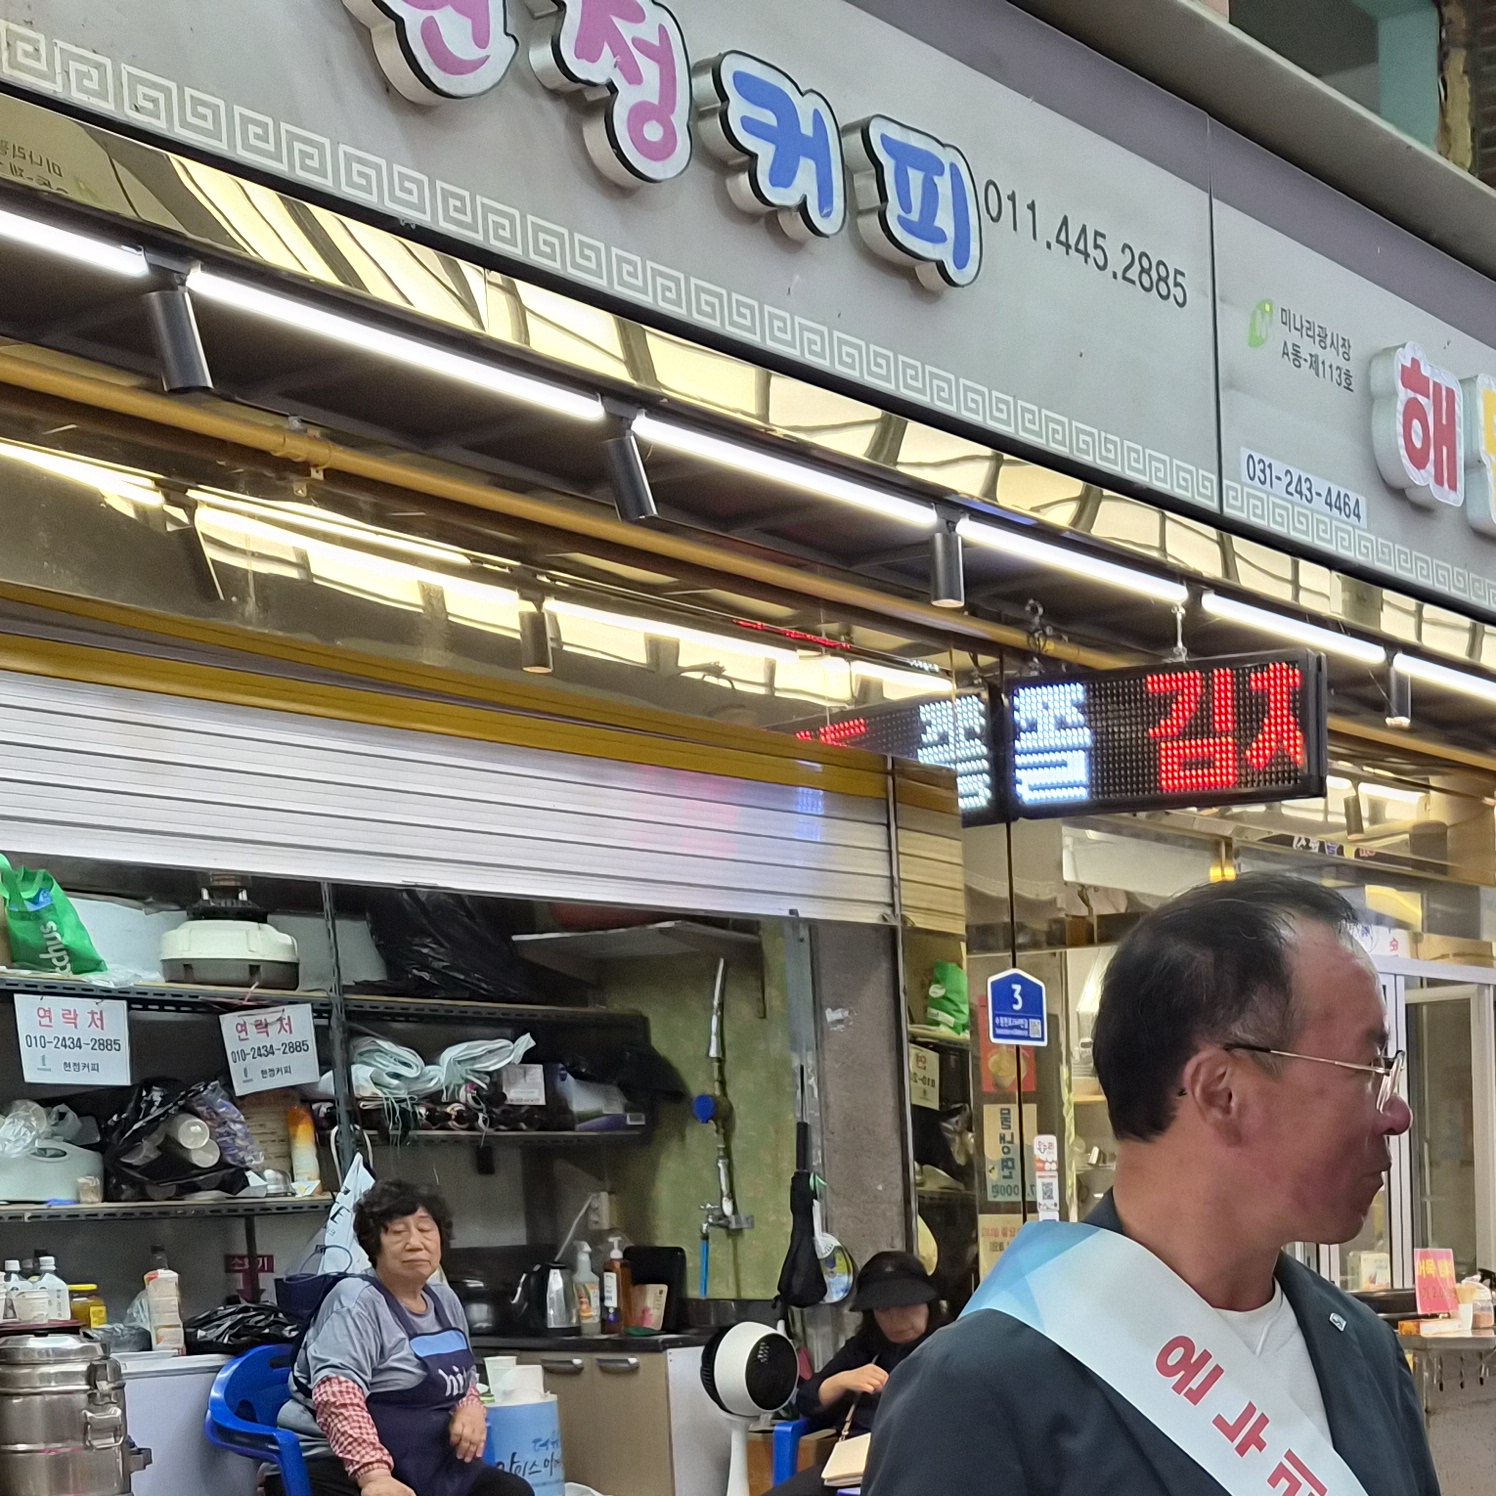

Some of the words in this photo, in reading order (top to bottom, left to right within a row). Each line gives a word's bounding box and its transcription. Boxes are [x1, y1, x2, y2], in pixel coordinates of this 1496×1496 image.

[984, 178, 1188, 310] 011.445.2885
[1281, 307, 1352, 362] 미나리광시장
[1281, 341, 1354, 393] A동-제113호
[1246, 454, 1362, 523] 031-243-4464
[1011, 984, 1023, 1011] 3
[36, 1006, 106, 1031] 연락처
[235, 1015, 294, 1042] 연락처
[25, 1034, 121, 1052] 010-2434-2885
[230, 1040, 310, 1064] 010-2434-2885
[62, 1060, 100, 1074] 현정커피
[260, 1065, 293, 1080] 현정커피
